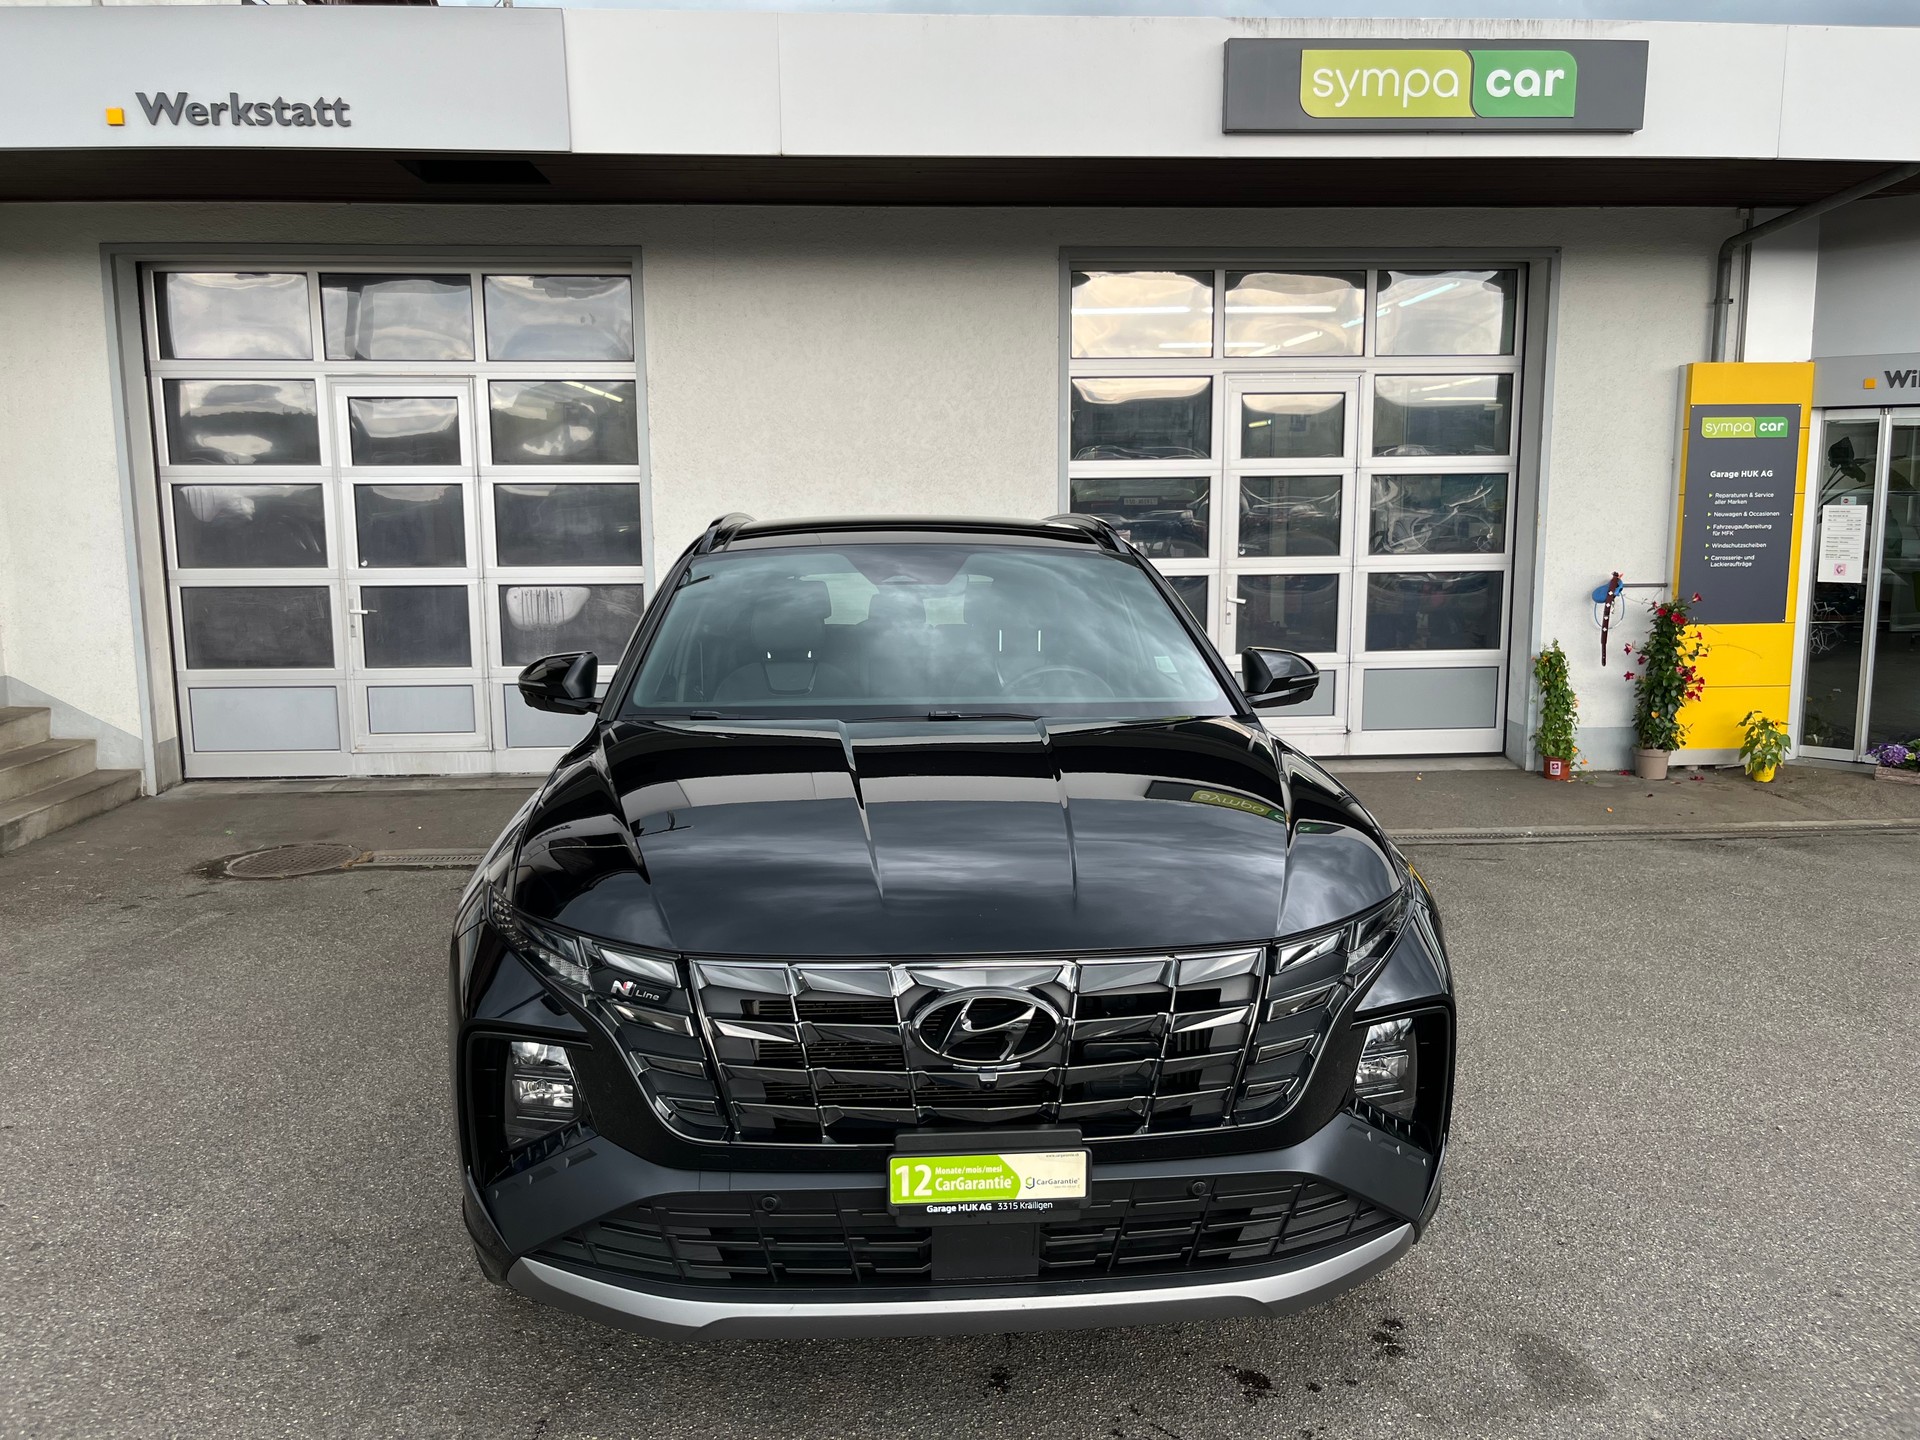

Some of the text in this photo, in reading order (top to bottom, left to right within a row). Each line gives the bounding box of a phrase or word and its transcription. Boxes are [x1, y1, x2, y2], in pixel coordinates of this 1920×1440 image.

[1312, 66, 1565, 108] sympa car
[135, 92, 352, 127] Werkstatt
[1705, 421, 1785, 435] sympa car
[1710, 470, 1739, 479] Garage
[1741, 470, 1759, 478] HUK
[635, 990, 660, 1001] Line
[895, 1164, 1002, 1197] 12 Monate/mois/mesi
[926, 1200, 1053, 1214] Garage HUK AG 3315 Kräiligen
